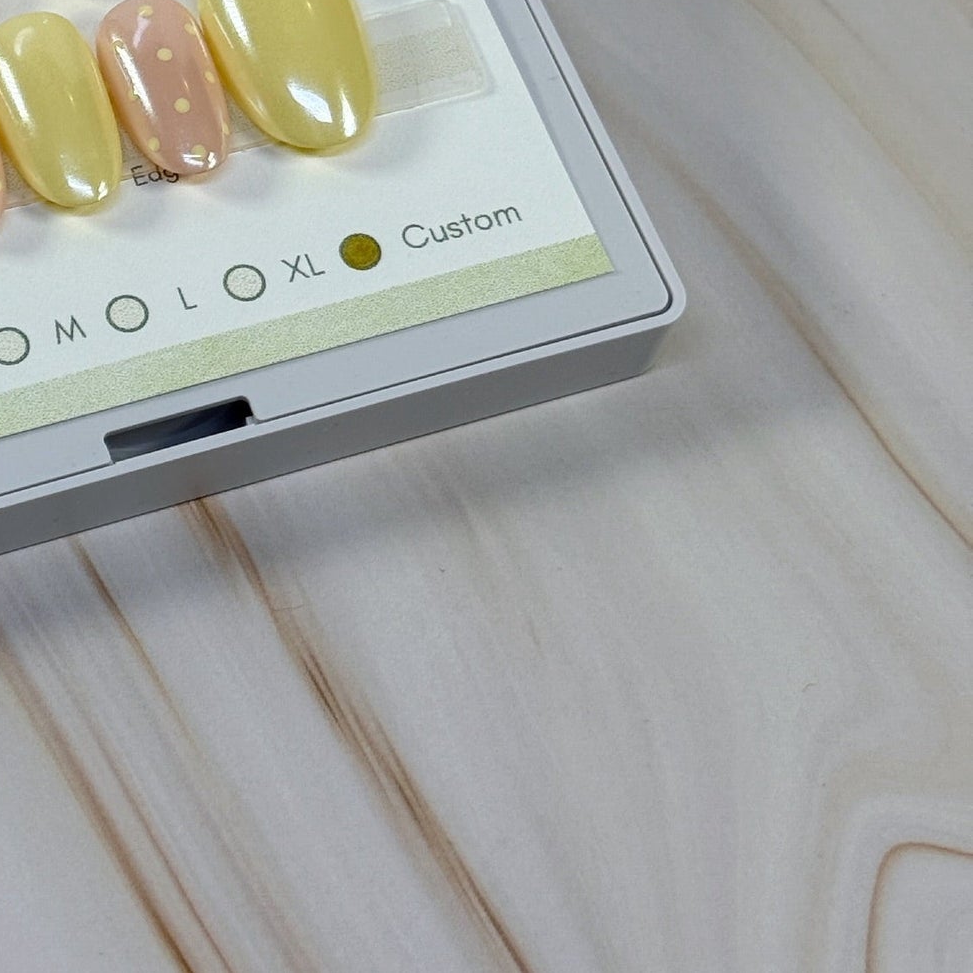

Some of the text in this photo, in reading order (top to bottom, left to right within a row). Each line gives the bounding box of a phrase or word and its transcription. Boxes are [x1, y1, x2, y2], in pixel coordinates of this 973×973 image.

[55, 315, 87, 345] M
[177, 287, 199, 311] L
[280, 254, 327, 283] XL
[402, 207, 522, 248] Custom
